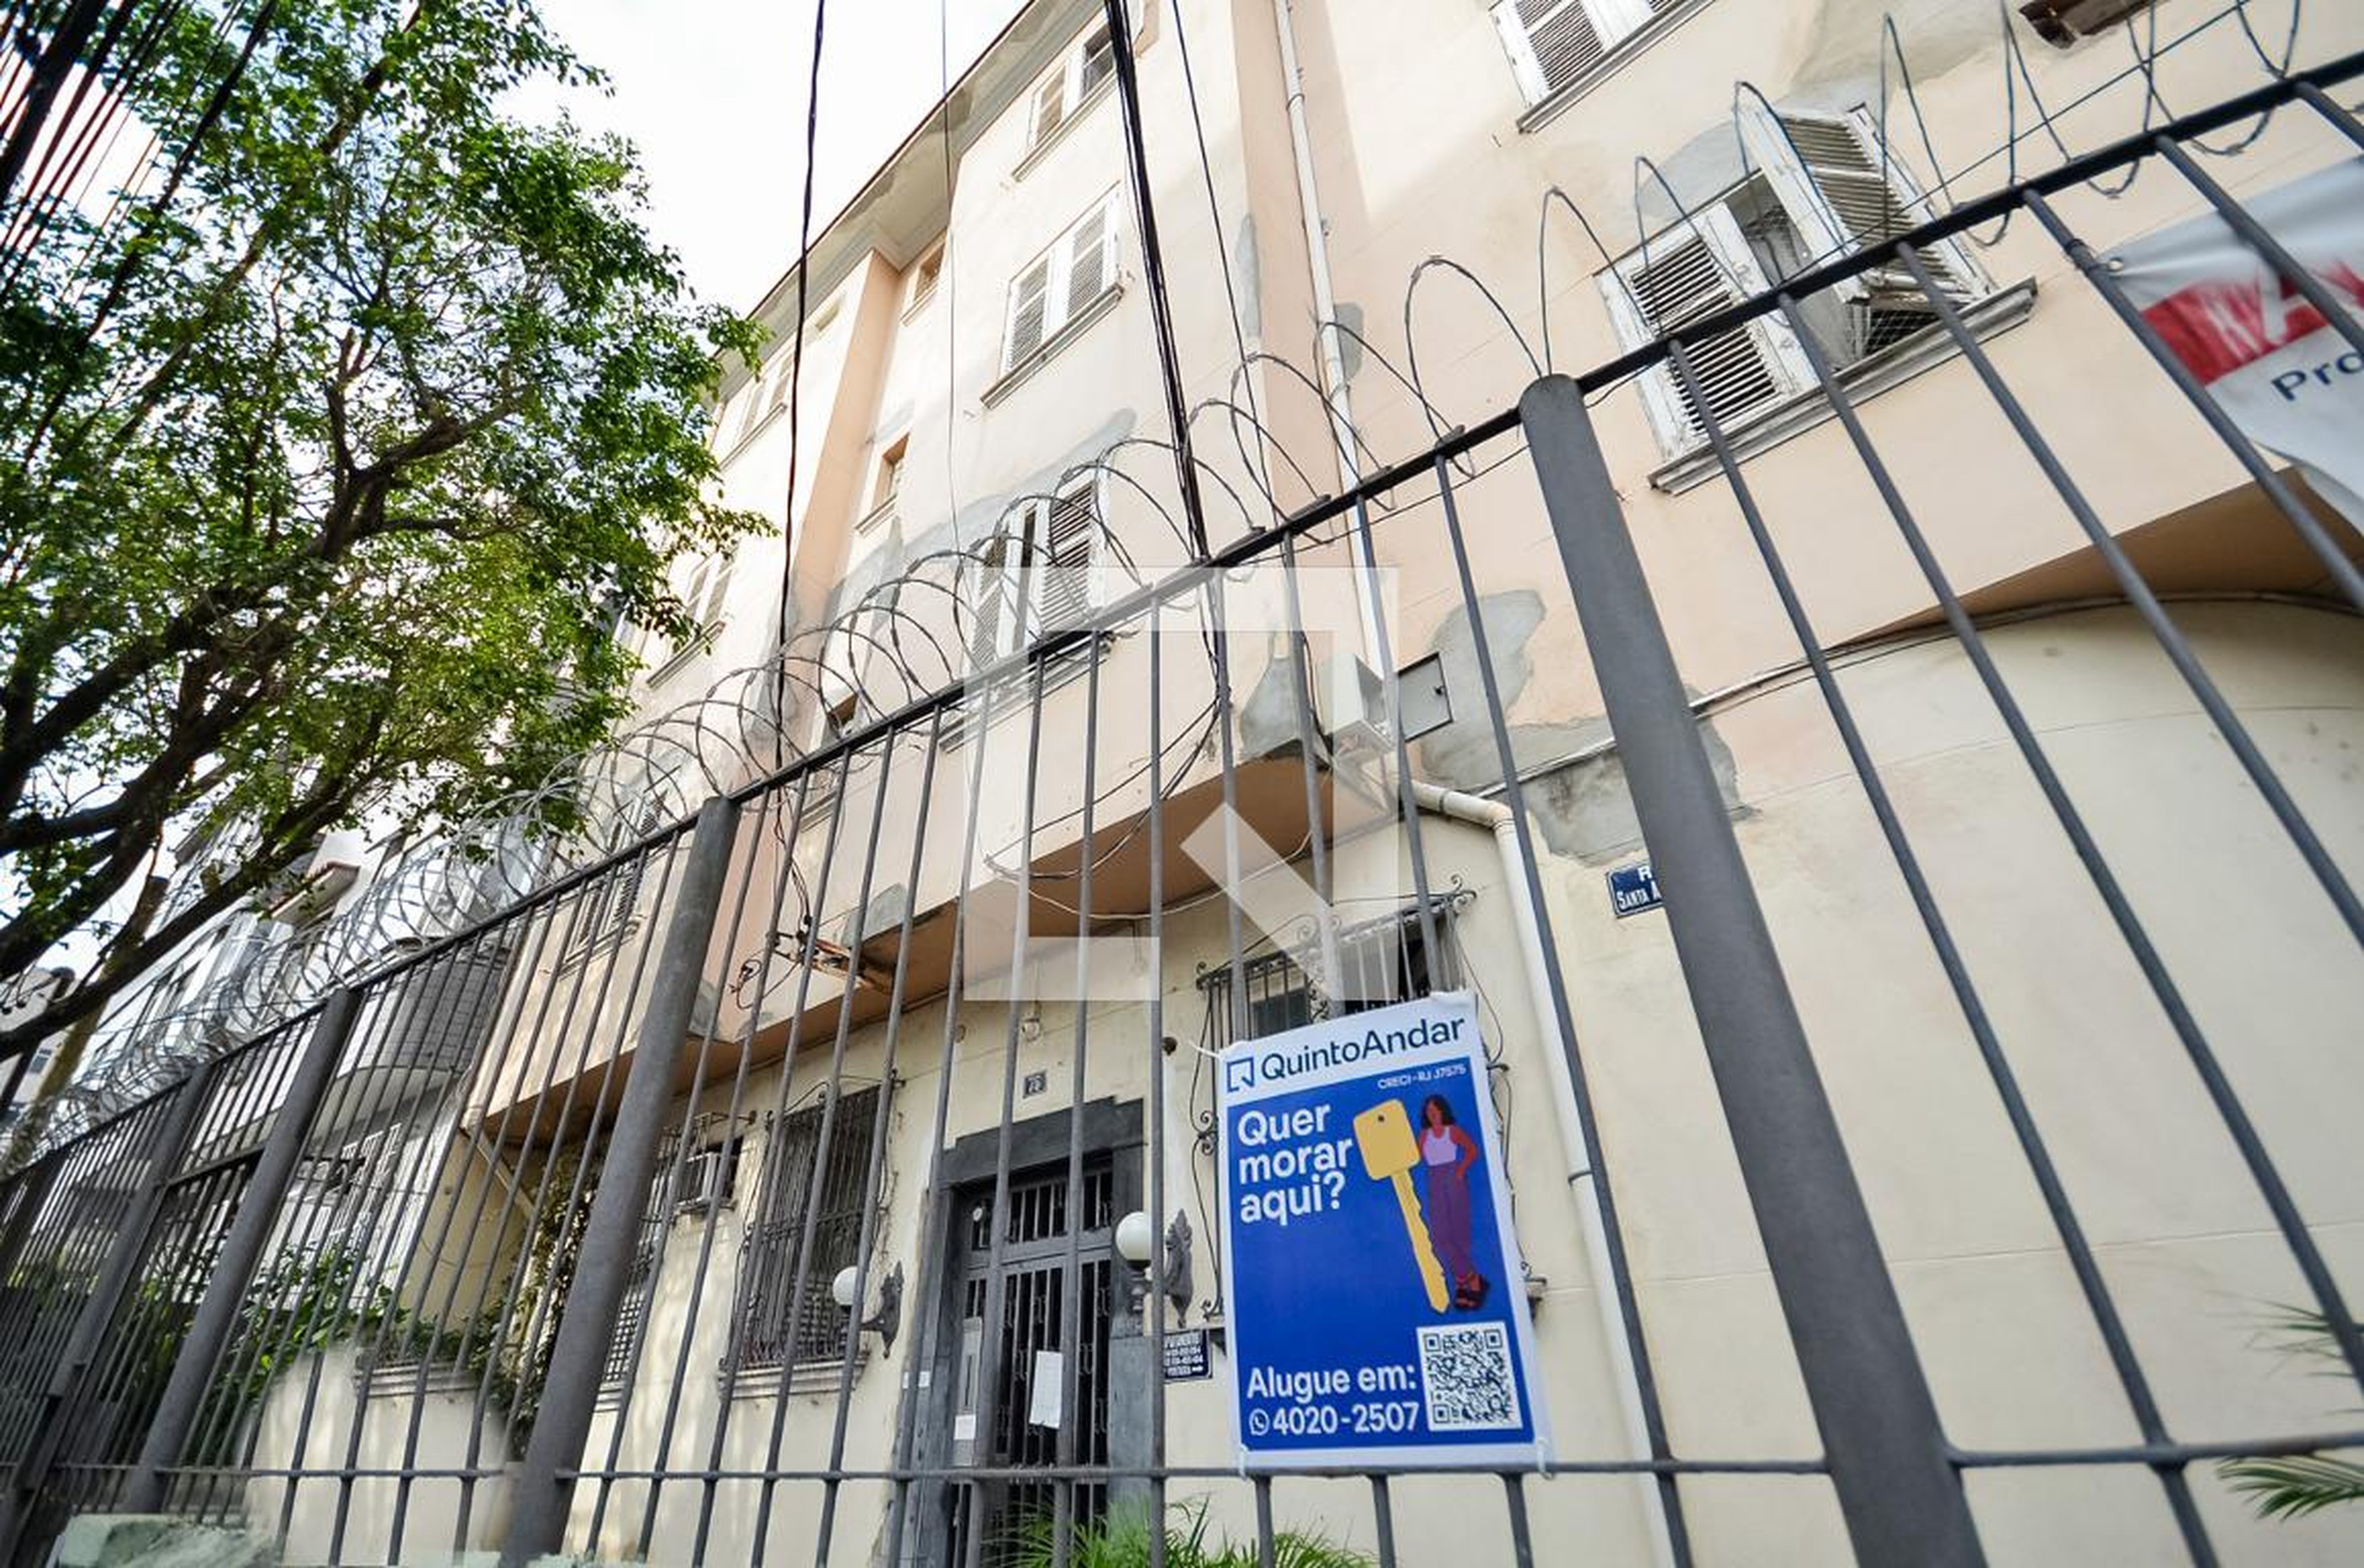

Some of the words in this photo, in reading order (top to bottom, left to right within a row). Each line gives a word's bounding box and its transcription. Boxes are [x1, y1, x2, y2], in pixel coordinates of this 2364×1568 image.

[1261, 1018, 1465, 1080] QuintoAndar
[1238, 1104, 1330, 1146] Quer
[1239, 1139, 1353, 1184] morar
[1240, 1171, 1346, 1226] aqui?
[1247, 1365, 1350, 1404] Alugue
[1358, 1365, 1417, 1392] em:
[1272, 1402, 1419, 1435] 4020-2507
